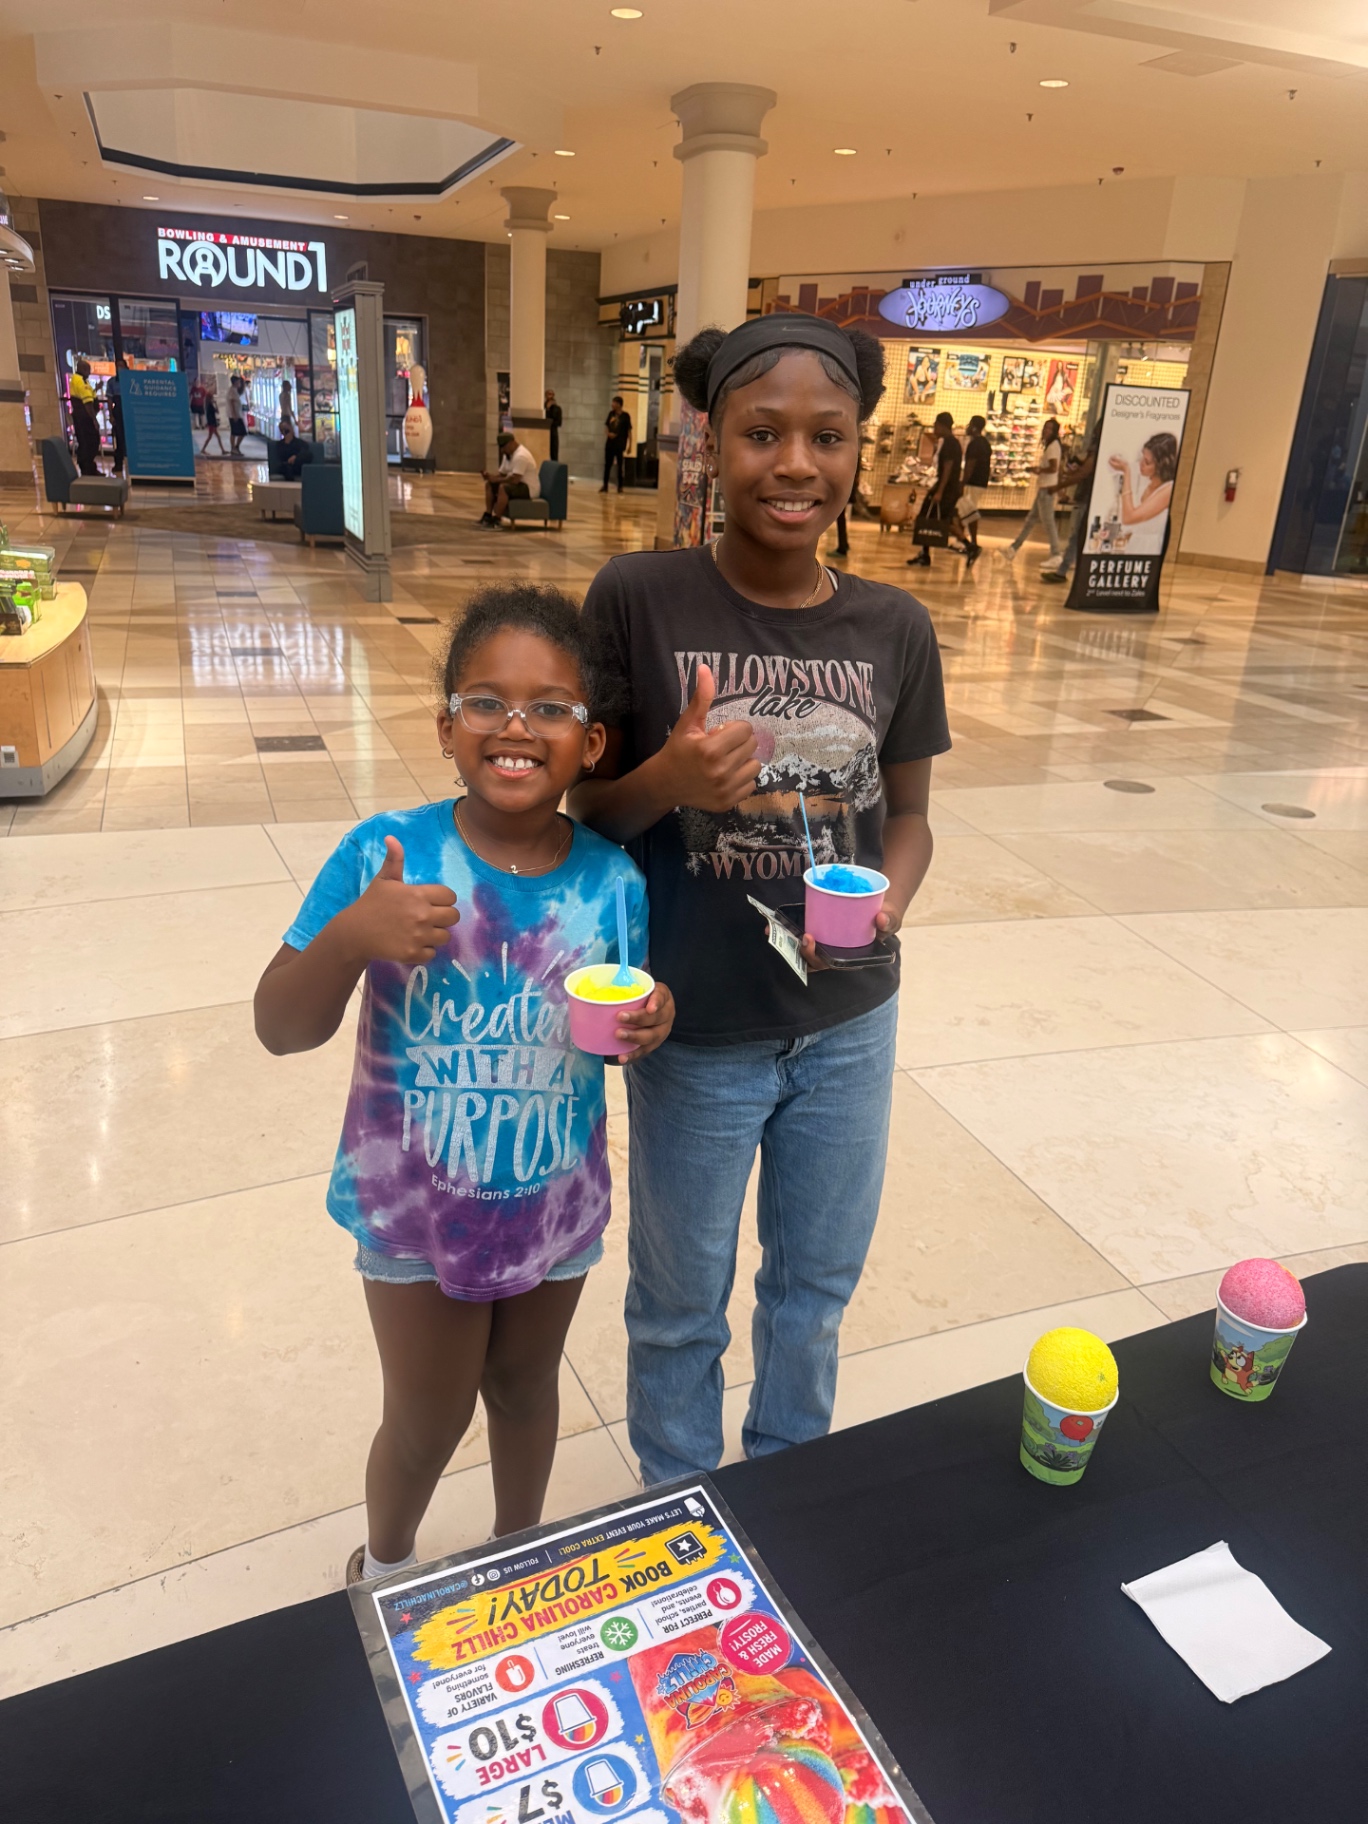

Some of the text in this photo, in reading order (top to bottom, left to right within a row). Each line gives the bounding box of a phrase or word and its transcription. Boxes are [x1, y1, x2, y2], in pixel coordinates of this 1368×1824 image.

[158, 227, 306, 251] BOWLING & AMUSEMENT
[158, 239, 327, 292] ROUND1
[910, 274, 970, 288] under ground
[1115, 394, 1180, 408] DISCOUNTED
[1090, 560, 1152, 574] PERFUME
[1089, 575, 1149, 588] GALLERY
[748, 685, 821, 720] lake
[421, 1049, 570, 1088] WITH A
[402, 1089, 580, 1184] PURPOSE
[431, 1174, 541, 1200] Ephesians 2:10
[558, 1507, 682, 1556] LET'S MAKE YOUR EVENT EXTRA COOL!
[502, 1565, 512, 1574] US
[513, 1557, 539, 1571] FOLLOW
[394, 1580, 468, 1611] @CAROLINACHILLZ
[488, 1558, 611, 1626] TODAY!
[651, 1585, 698, 1607] celebrations!
[661, 1593, 702, 1613] events, and
[451, 1560, 673, 1661] BOOK CAROLINA CHILLZ
[655, 1599, 707, 1626] parties, school
[662, 1609, 713, 1634] PERFECT FOR
[557, 1624, 591, 1643] will love!
[560, 1633, 595, 1651] everyone
[728, 1620, 768, 1650] FROSTY!
[738, 1630, 778, 1660] FRESH &
[576, 1642, 600, 1655] treats
[752, 1643, 783, 1668] MADE
[554, 1650, 604, 1676] REFRESHING
[432, 1664, 486, 1689] for everyone!
[446, 1673, 489, 1694] something
[664, 1663, 732, 1709] CAROLINA
[446, 1692, 497, 1718] VARIETY OF
[454, 1682, 493, 1703] FLAVORS
[468, 1714, 537, 1761] $10
[475, 1744, 547, 1786] LARGE
[517, 1780, 563, 1824] $7
